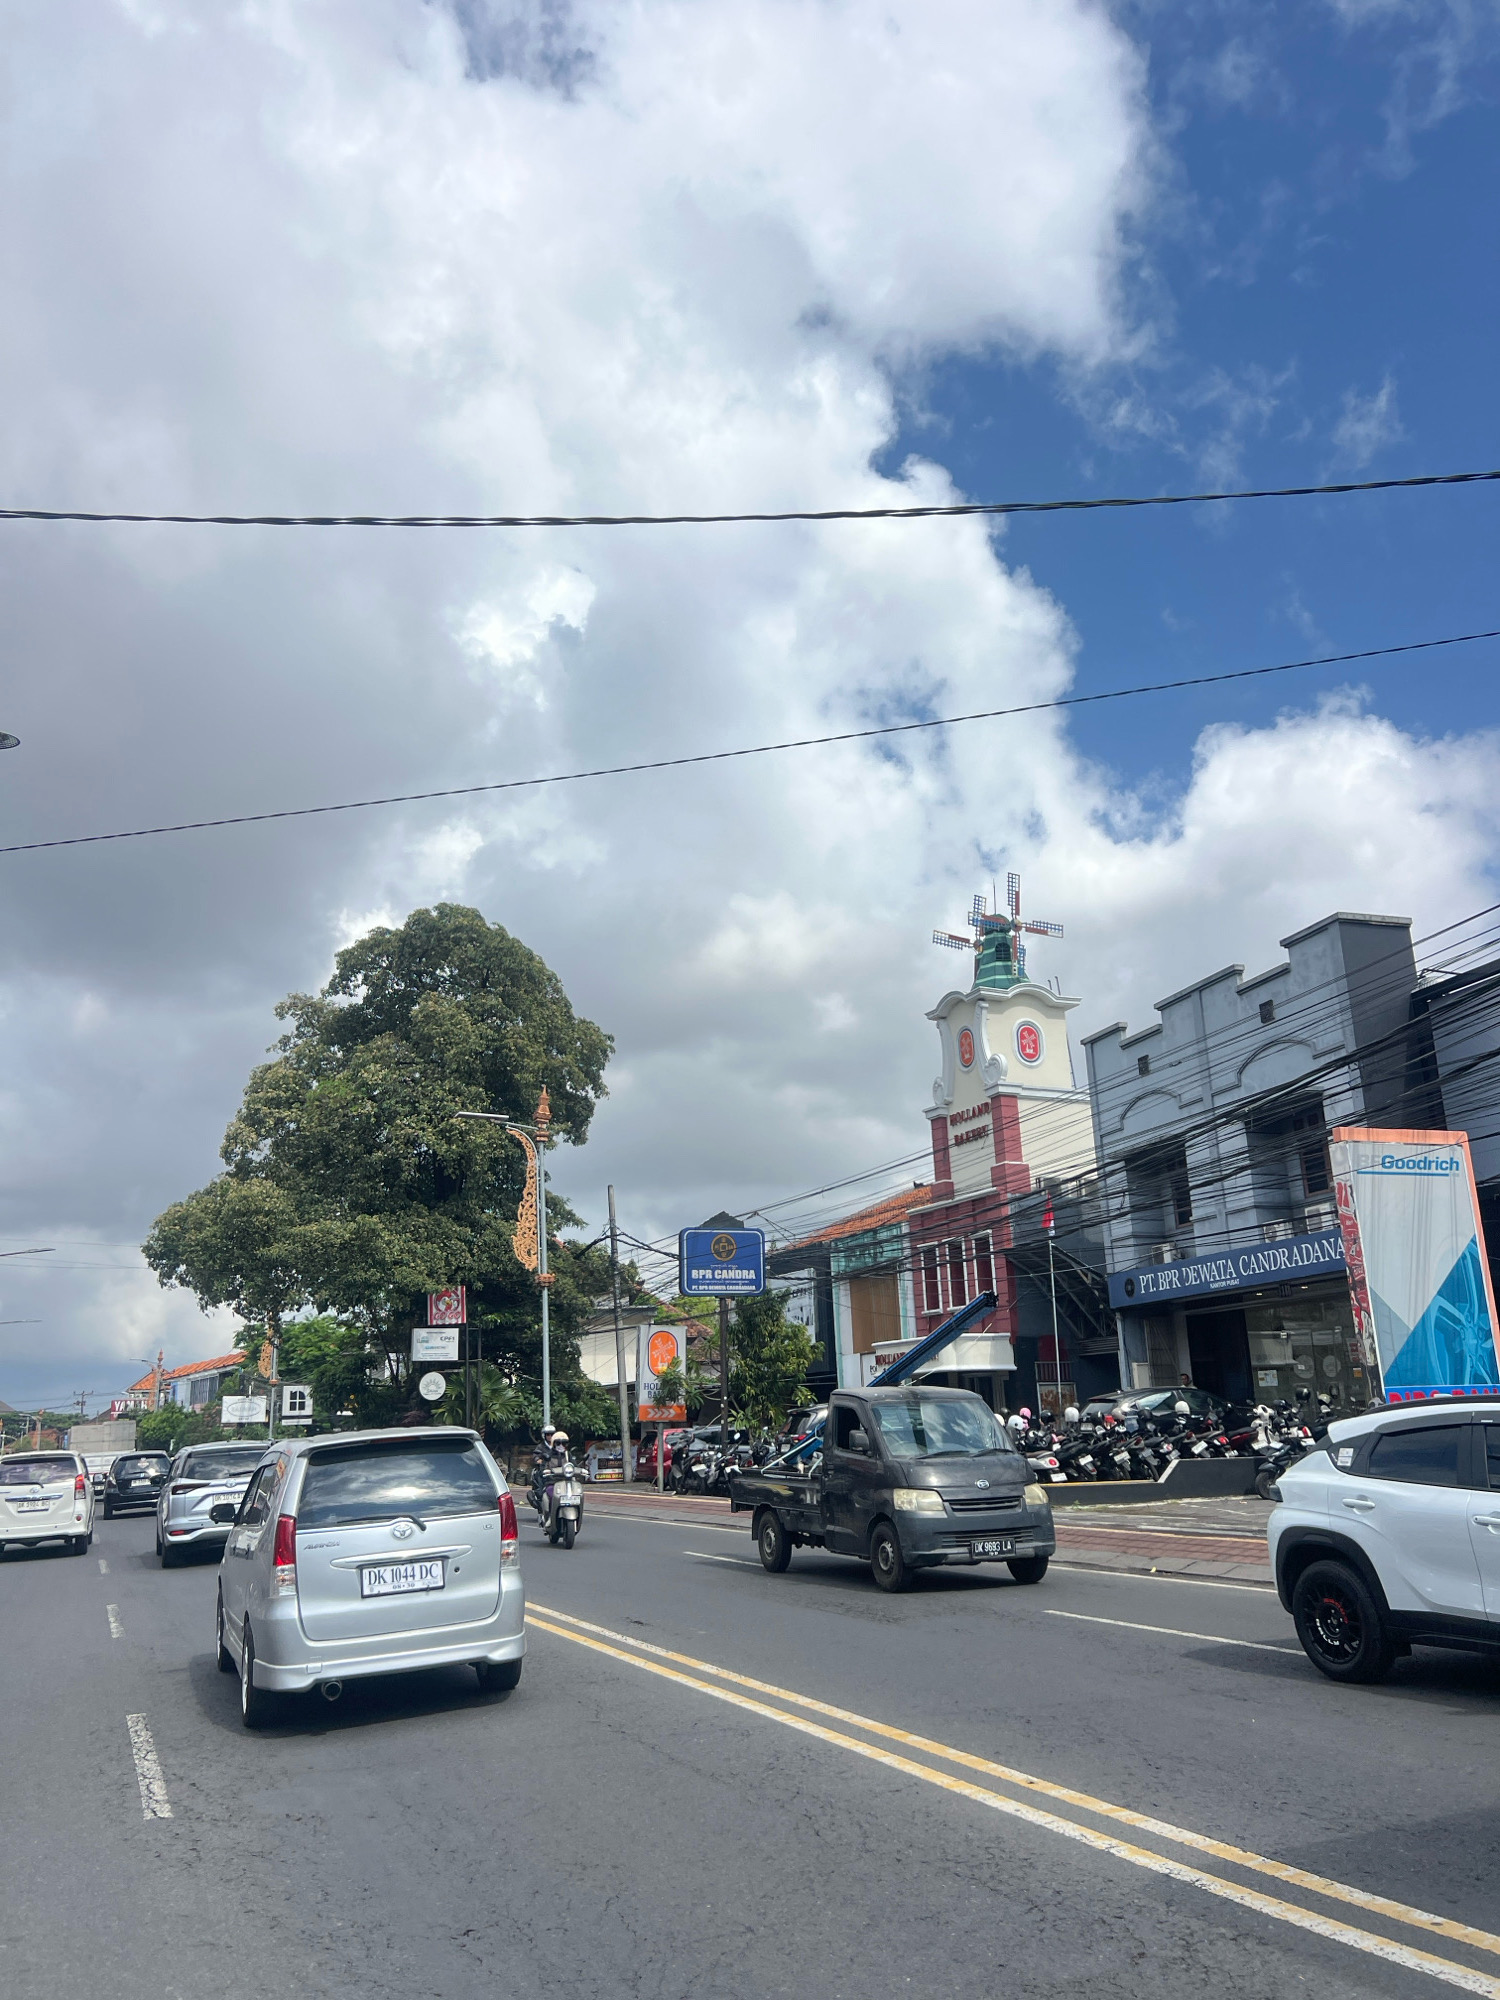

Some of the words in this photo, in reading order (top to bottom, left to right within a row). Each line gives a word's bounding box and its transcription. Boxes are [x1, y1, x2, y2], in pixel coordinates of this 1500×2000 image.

[950, 1102, 990, 1126] HOLLAND
[954, 1125, 988, 1146] BAKERY
[691, 1269, 713, 1280] BPR
[714, 1269, 757, 1280] CANDRA
[1139, 1274, 1157, 1293] PT.
[1157, 1269, 1182, 1290] BPR
[1183, 1257, 1237, 1285] DEWATA
[1239, 1236, 1345, 1277] CANDRADANA
[974, 1542, 984, 1553] DK
[1002, 1540, 1012, 1551] LA
[368, 1568, 388, 1585] DK
[391, 1565, 416, 1583] 1044
[420, 1562, 439, 1580] DC
